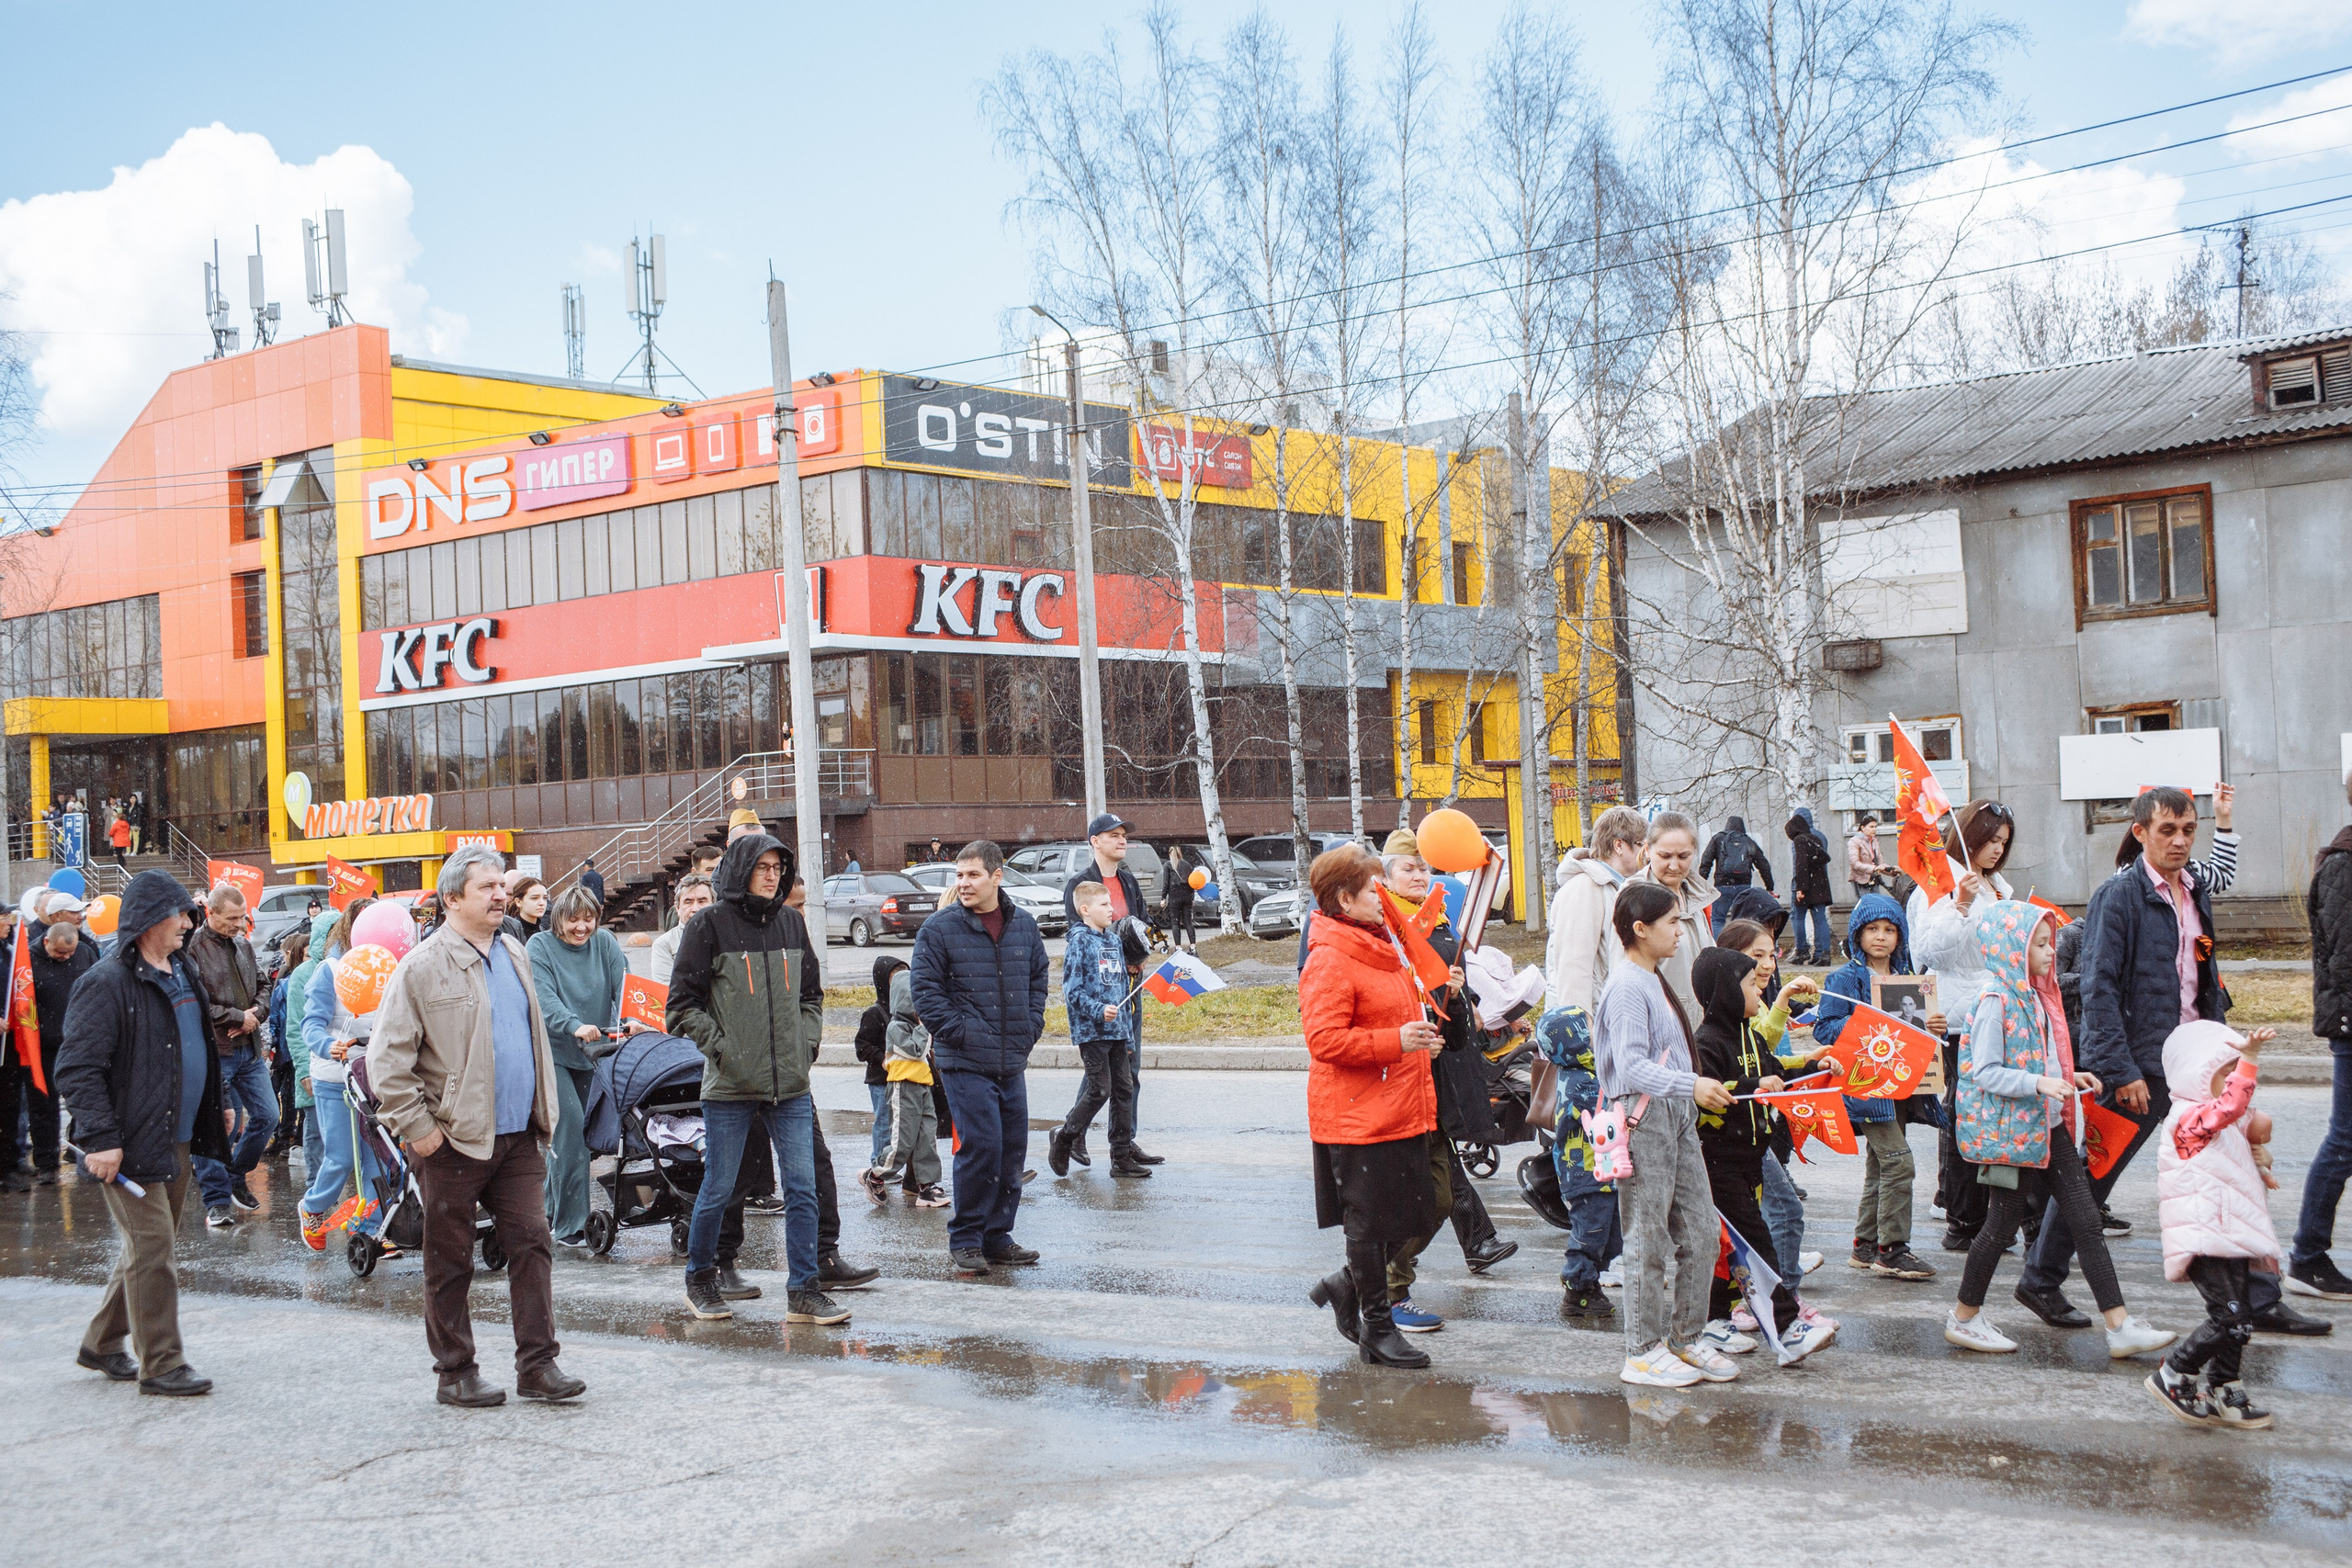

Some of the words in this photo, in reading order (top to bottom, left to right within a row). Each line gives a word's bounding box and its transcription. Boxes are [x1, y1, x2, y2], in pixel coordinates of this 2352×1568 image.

[368, 457, 511, 540] DNS
[526, 447, 615, 494] ГИПЕР
[910, 562, 1065, 641] KFC
[373, 617, 499, 694] KFC
[457, 836, 497, 851] ВХОД
[1894, 1061, 1912, 1081] 9
